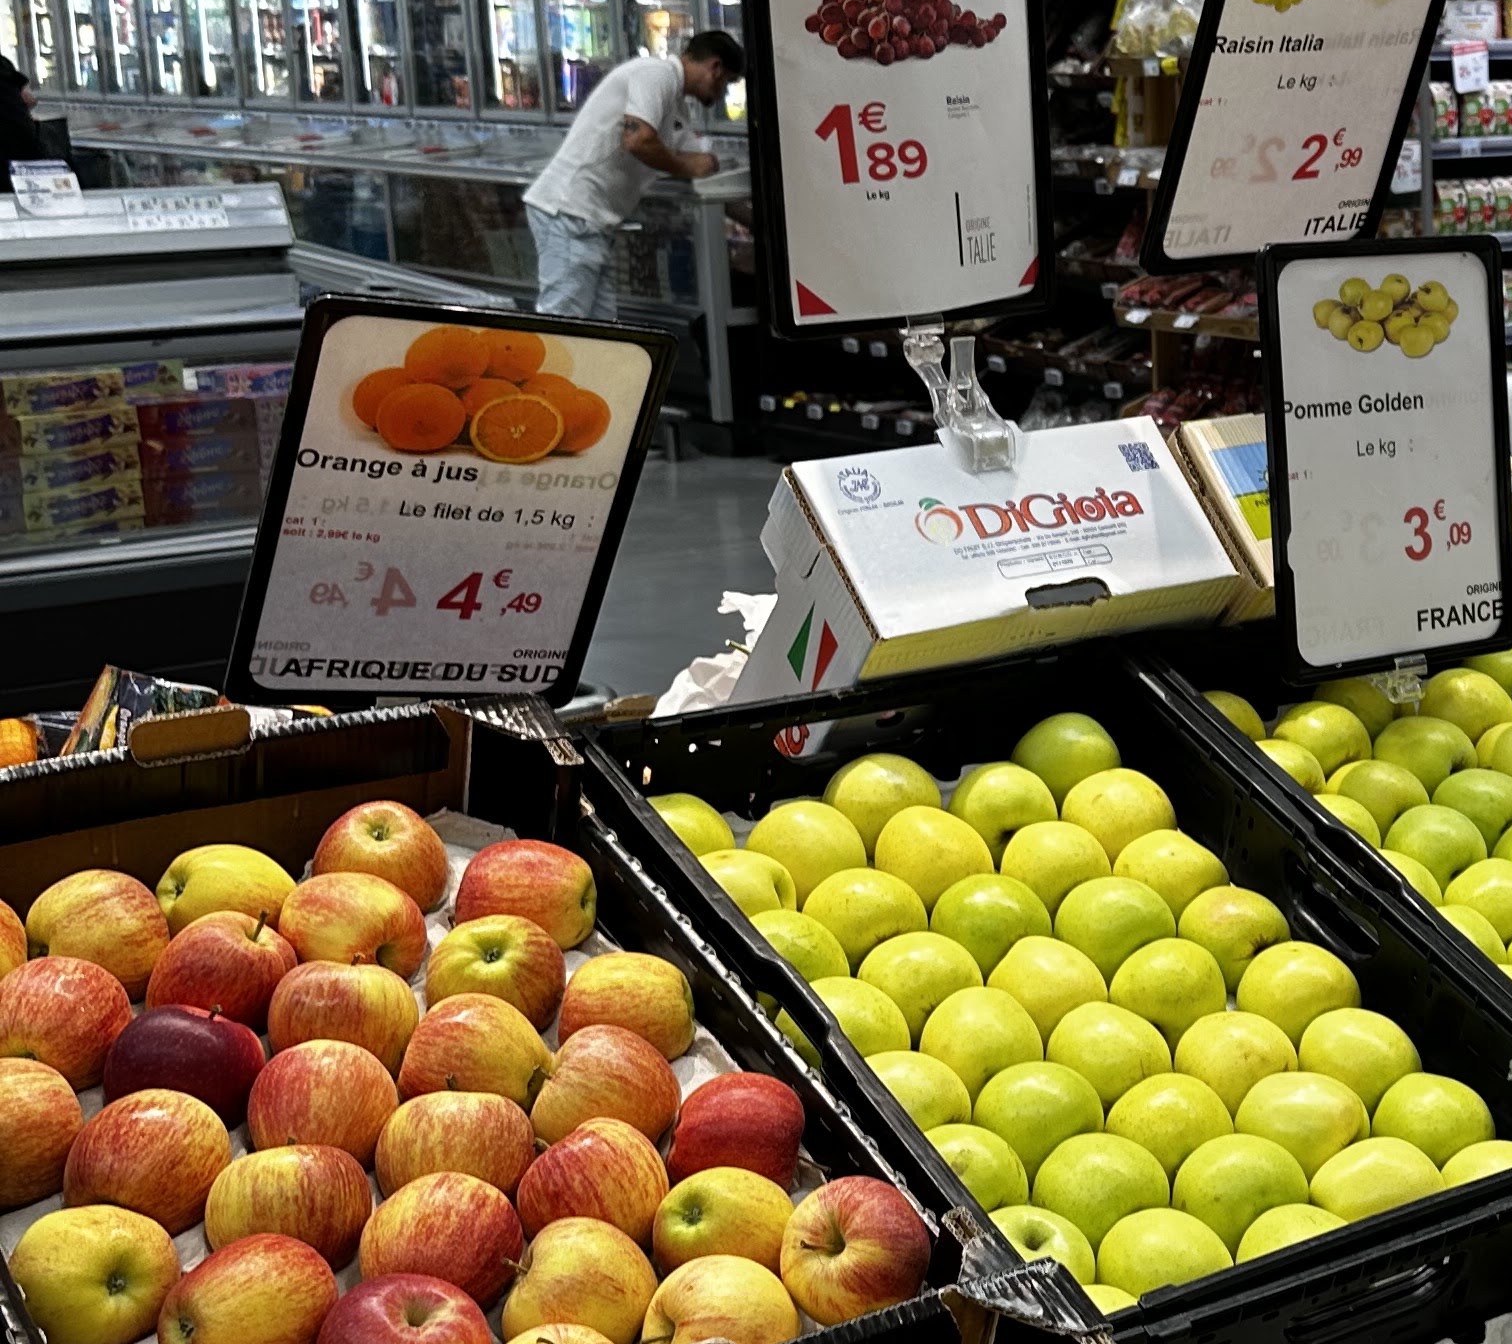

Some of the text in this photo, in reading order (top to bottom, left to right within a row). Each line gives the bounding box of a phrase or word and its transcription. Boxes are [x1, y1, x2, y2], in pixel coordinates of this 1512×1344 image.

[1214, 33, 1325, 54] Raisin Italia
[1277, 73, 1318, 92] Le kg
[814, 101, 888, 185] 1 €
[1292, 133, 1328, 181] 2
[866, 139, 929, 182] 89
[866, 189, 890, 203] Le kg
[1284, 392, 1424, 420] Pomme Golden
[1356, 439, 1375, 457] Le
[1379, 438, 1397, 459] kg
[296, 448, 479, 485] Orange à jus
[284, 515, 305, 526] cat
[398, 500, 426, 519] Le
[432, 501, 473, 522] filet
[477, 506, 505, 523] de
[513, 506, 545, 528] 1,5
[550, 510, 576, 531] kg
[958, 487, 1145, 540] DiGioia
[282, 526, 306, 538] soit
[365, 532, 381, 545] kg
[1403, 506, 1433, 562] 3
[436, 571, 484, 621] 4
[499, 593, 543, 617] ,49
[1416, 598, 1503, 632] FRANCE
[279, 658, 565, 686] AFRIQUE DU SUD
